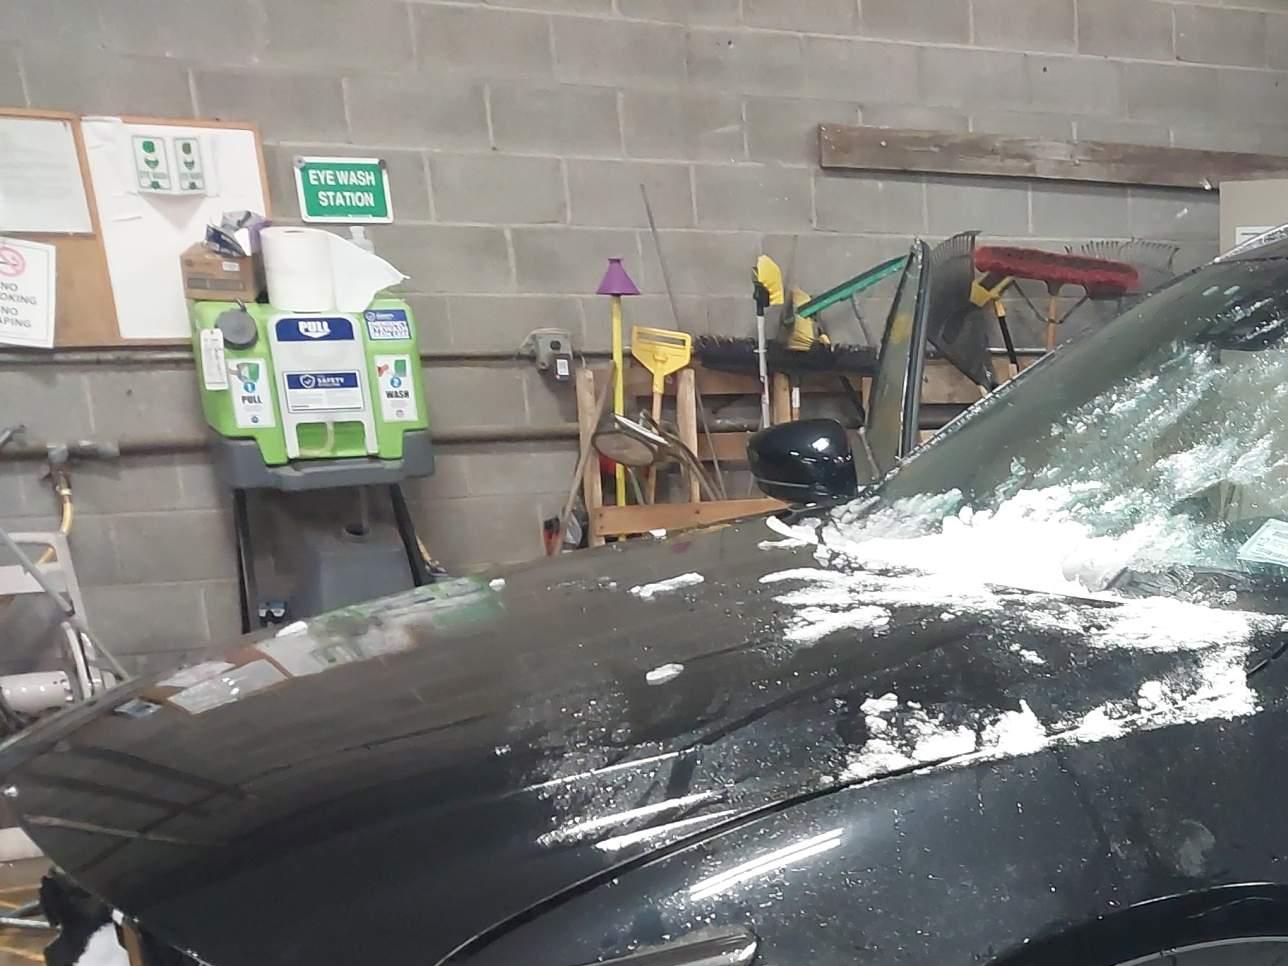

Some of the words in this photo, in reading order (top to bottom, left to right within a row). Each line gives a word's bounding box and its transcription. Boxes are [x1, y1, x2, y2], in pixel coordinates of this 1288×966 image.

[308, 169, 336, 185] EYE
[336, 170, 376, 186] WASH
[318, 191, 375, 207] STATION
[0, 281, 18, 292] NO
[1, 306, 18, 316] NO
[298, 321, 331, 333] PULL
[241, 395, 263, 404] PULL
[385, 390, 410, 399] WASH
